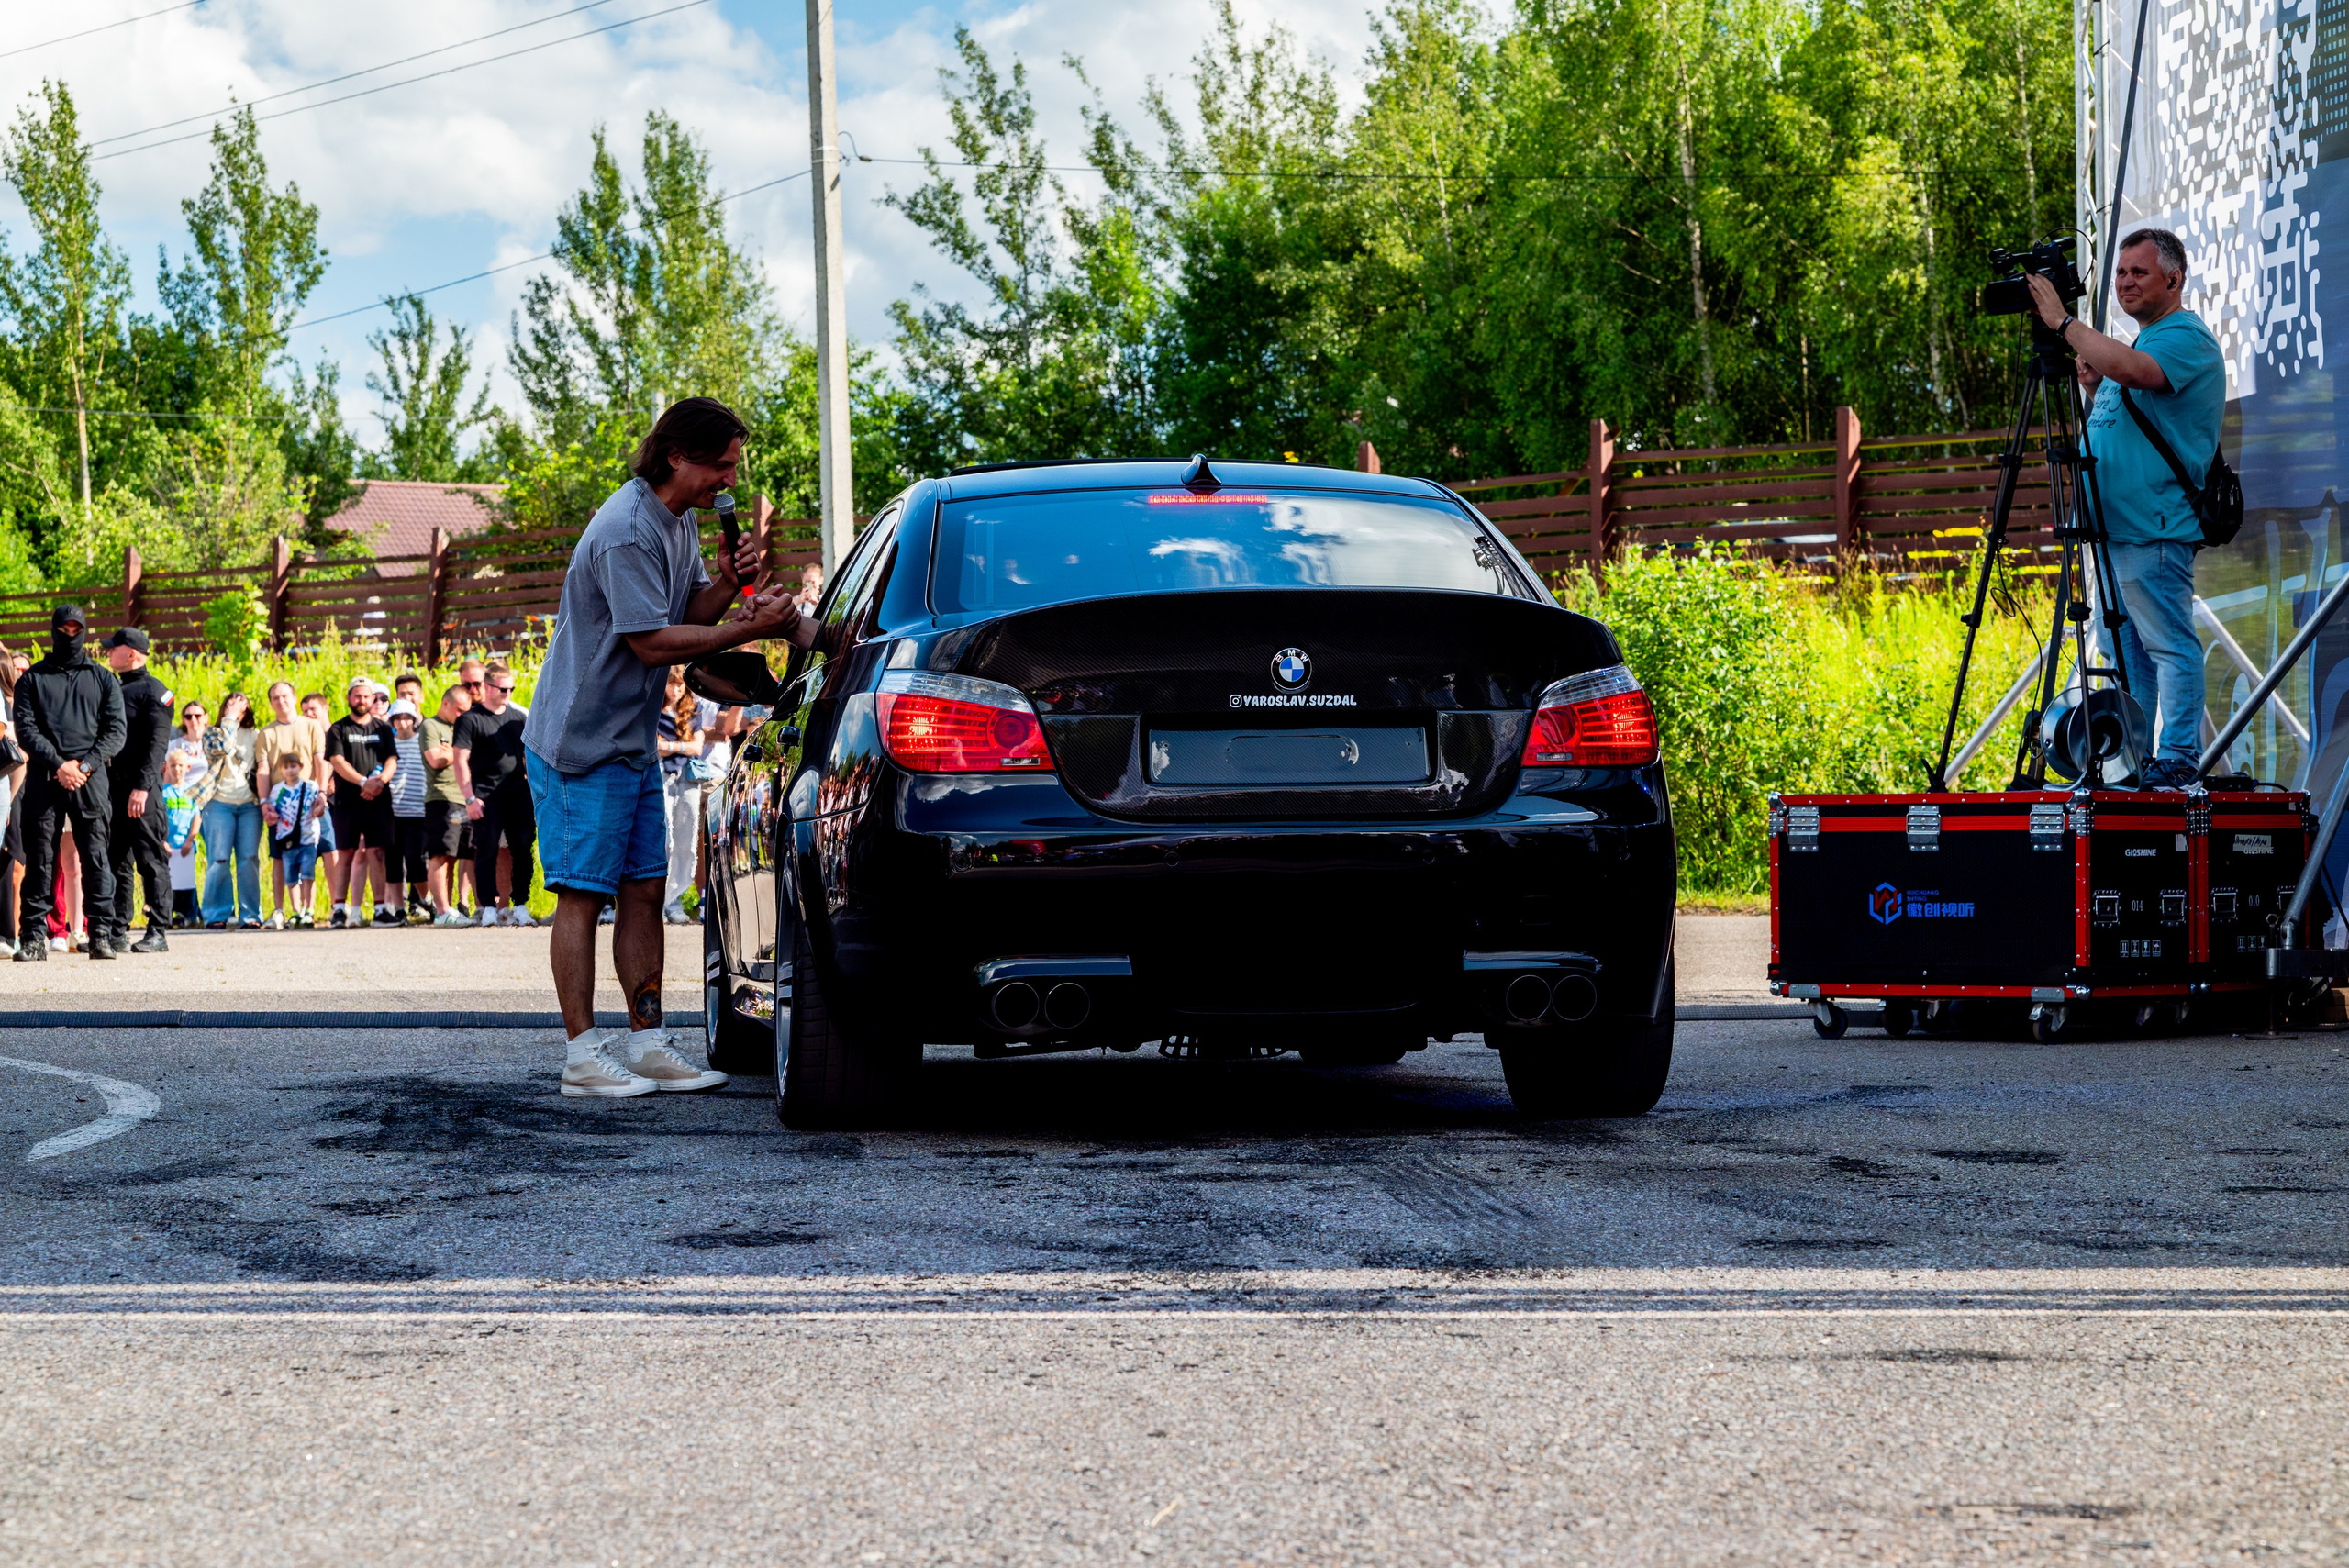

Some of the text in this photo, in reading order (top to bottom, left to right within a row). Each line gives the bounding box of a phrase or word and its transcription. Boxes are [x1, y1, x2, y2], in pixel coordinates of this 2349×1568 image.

[1275, 649, 1308, 663] BMW
[1243, 695, 1357, 706] YAROSLAV.SUZDAL
[2132, 900, 2143, 911] 014
[2248, 895, 2260, 906] 010
